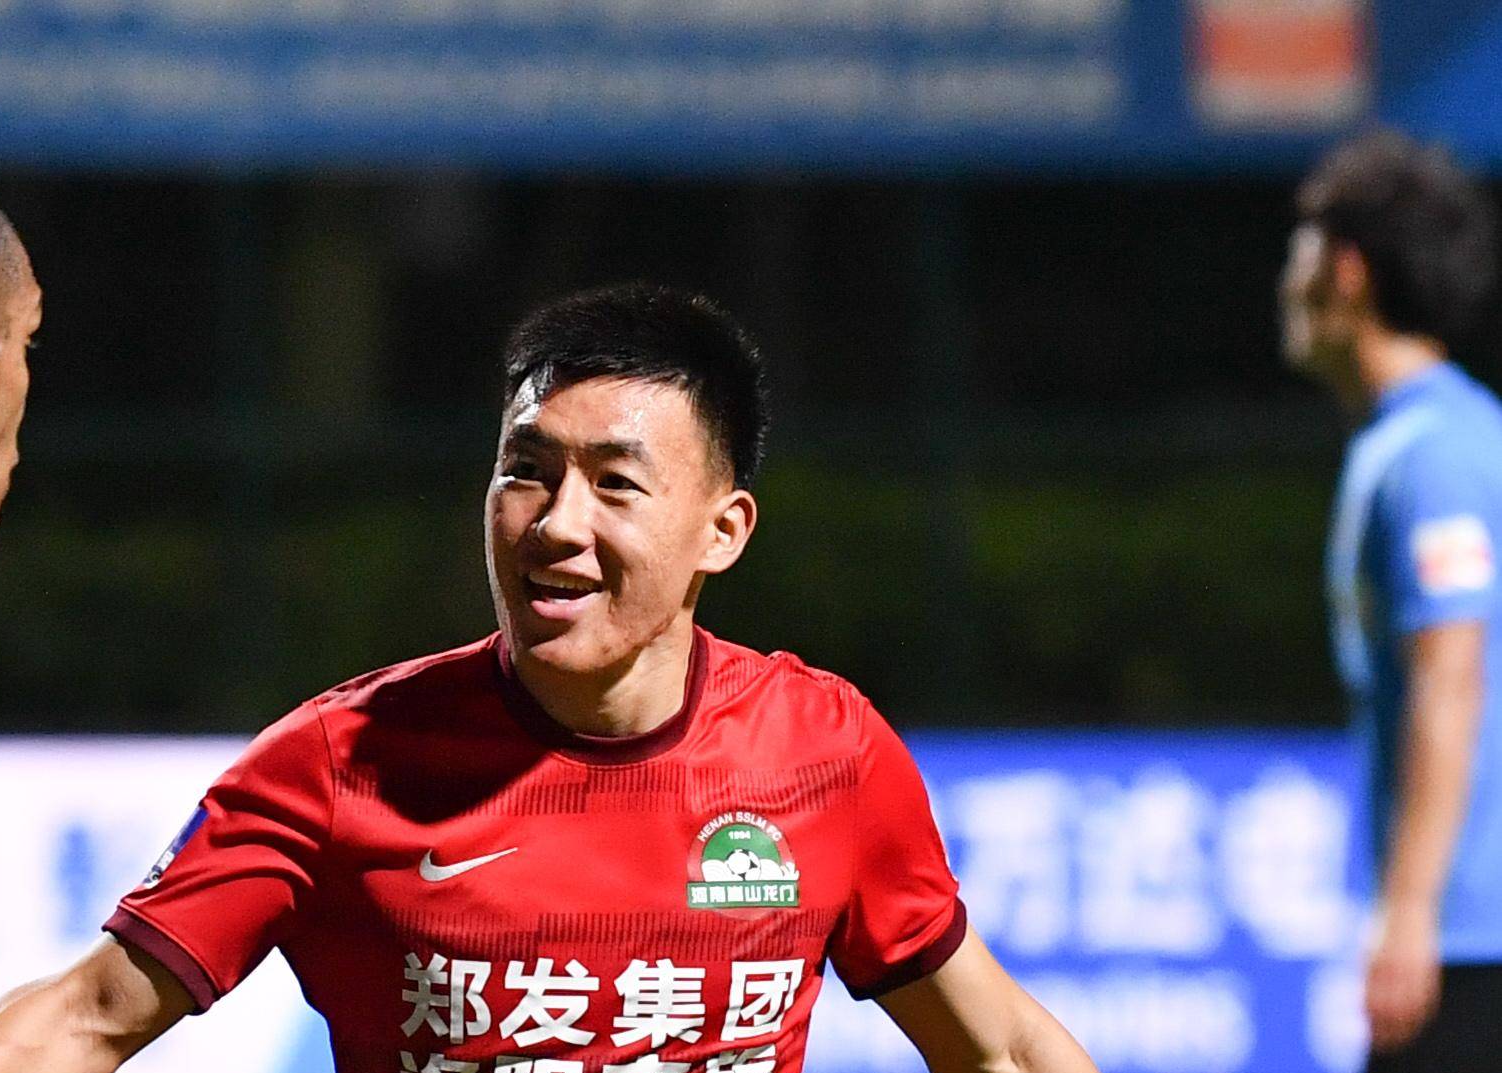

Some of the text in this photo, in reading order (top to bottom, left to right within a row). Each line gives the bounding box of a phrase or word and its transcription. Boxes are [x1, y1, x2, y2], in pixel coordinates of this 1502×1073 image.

[697, 812, 734, 843] HENAN
[765, 824, 783, 842] FC
[400, 952, 806, 1048] 郑发集团
